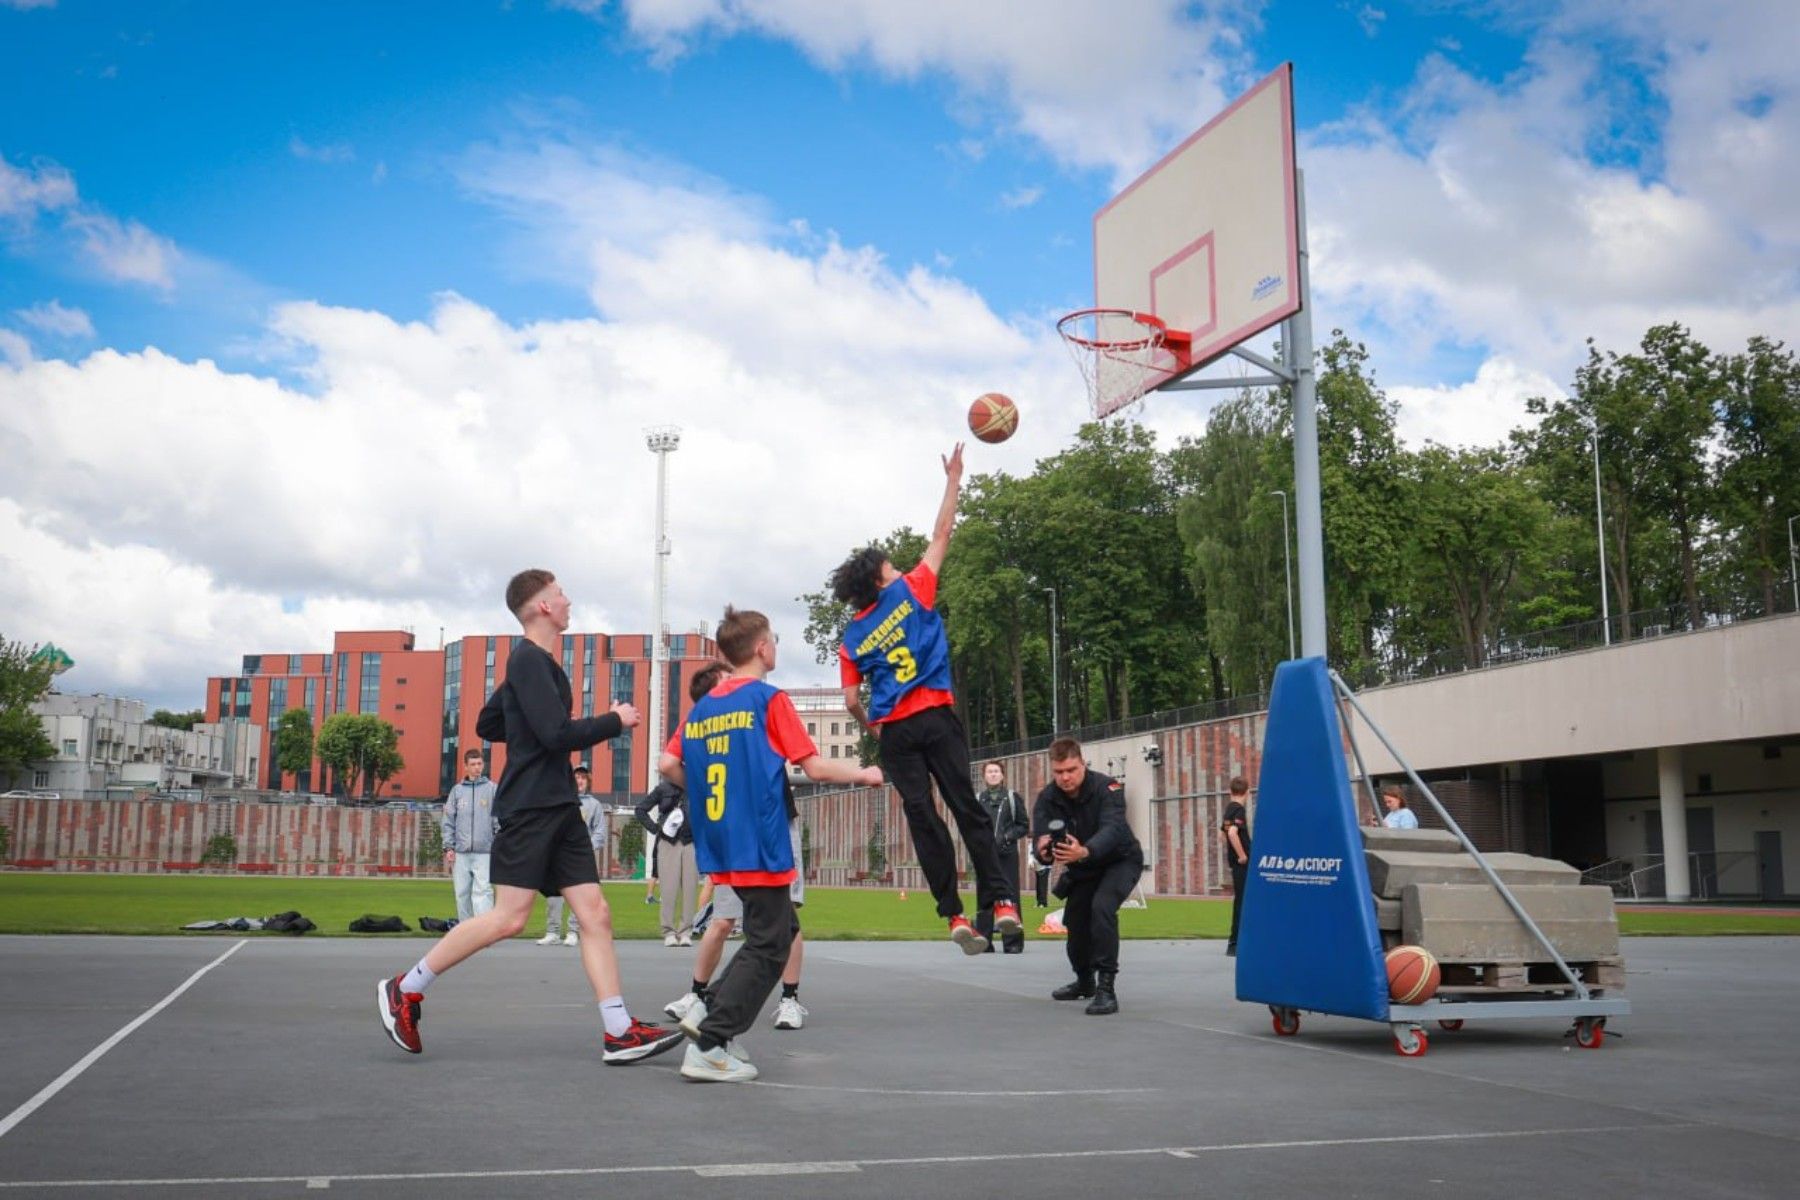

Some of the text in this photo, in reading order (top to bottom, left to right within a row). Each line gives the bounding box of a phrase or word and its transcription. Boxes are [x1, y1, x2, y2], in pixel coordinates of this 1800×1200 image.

[886, 646, 917, 684] 3
[706, 763, 727, 821] 3
[1259, 855, 1342, 872] АЛЬФАСПОРТ
